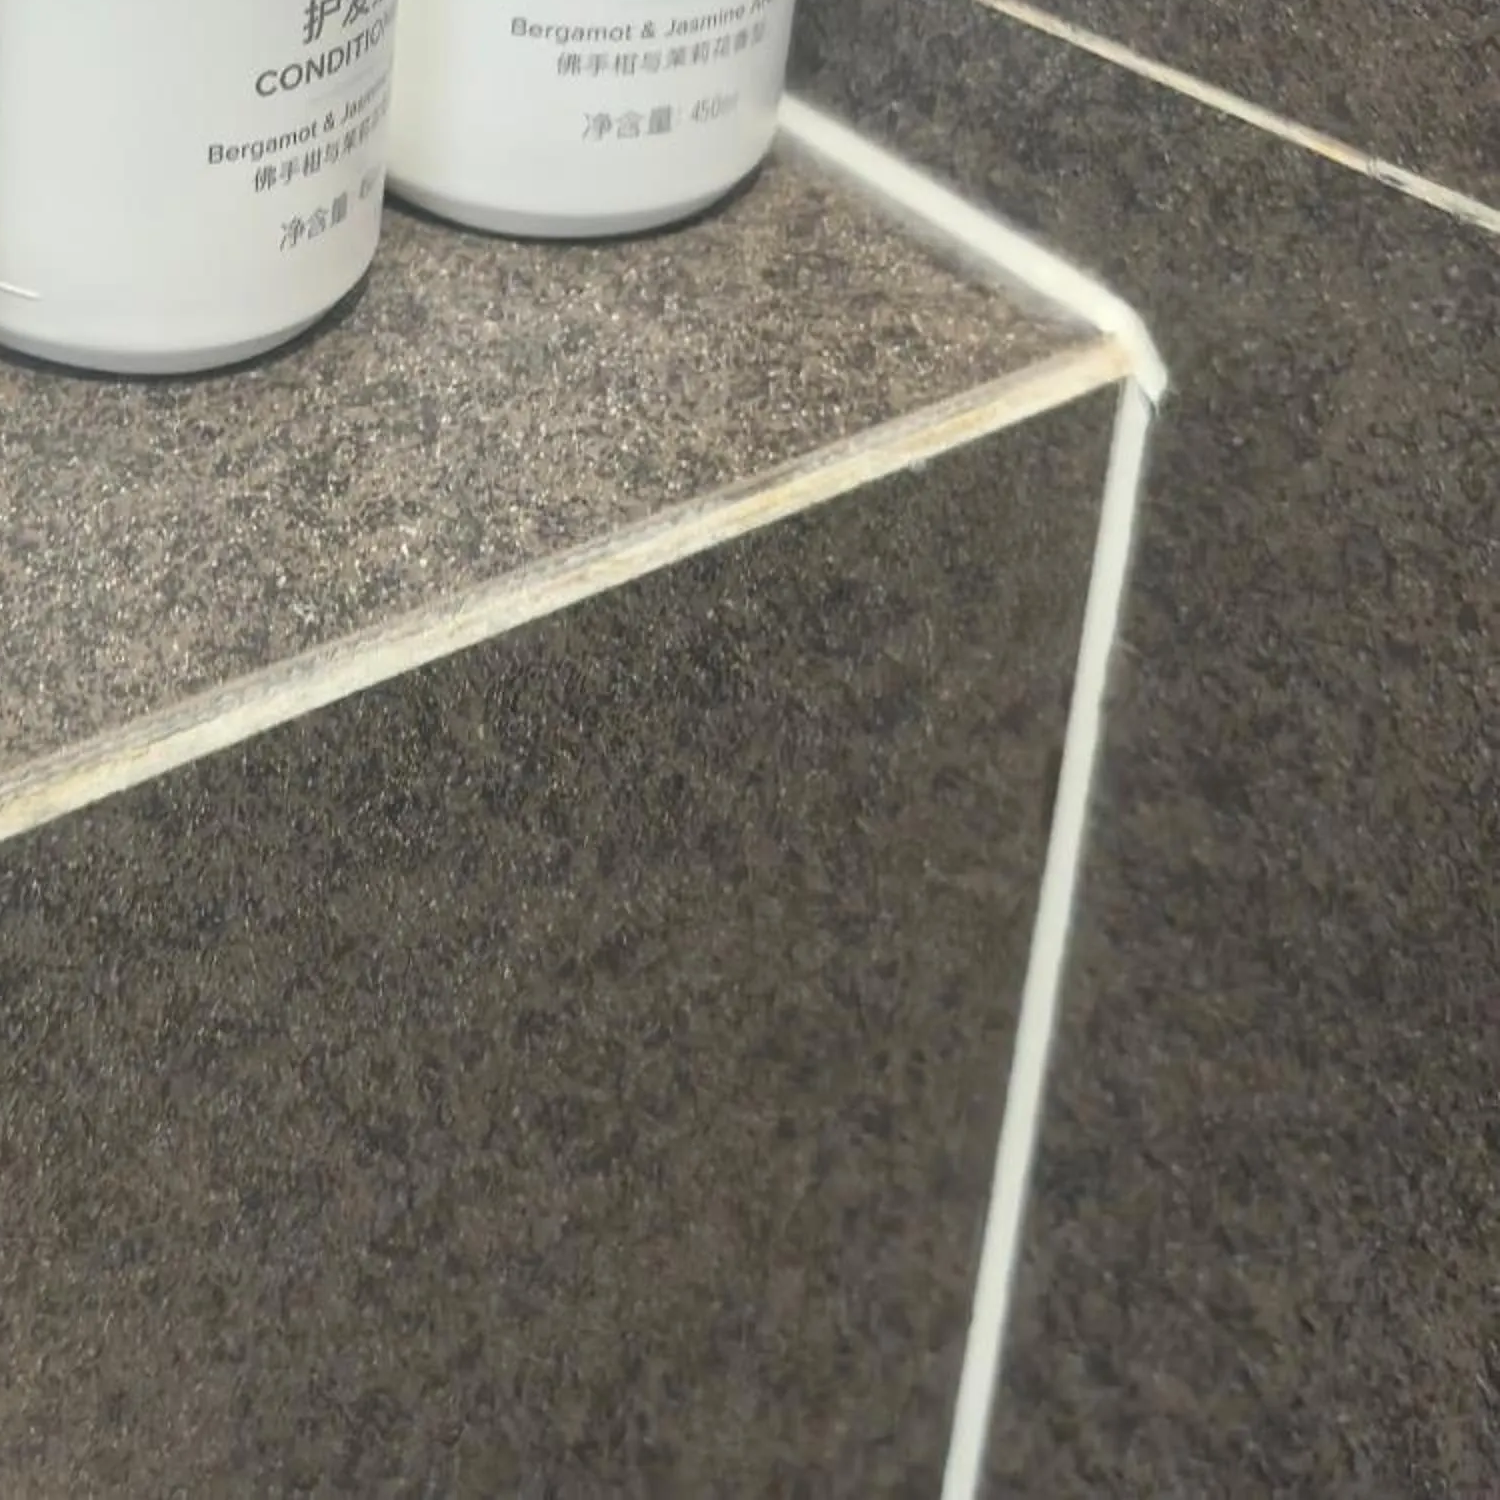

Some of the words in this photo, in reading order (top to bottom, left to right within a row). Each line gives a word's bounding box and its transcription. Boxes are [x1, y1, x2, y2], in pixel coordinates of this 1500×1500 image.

[510, 16, 632, 45] Bergamot
[640, 20, 655, 40] &
[664, 3, 746, 38] Jasmine
[208, 120, 317, 165] Bergamot
